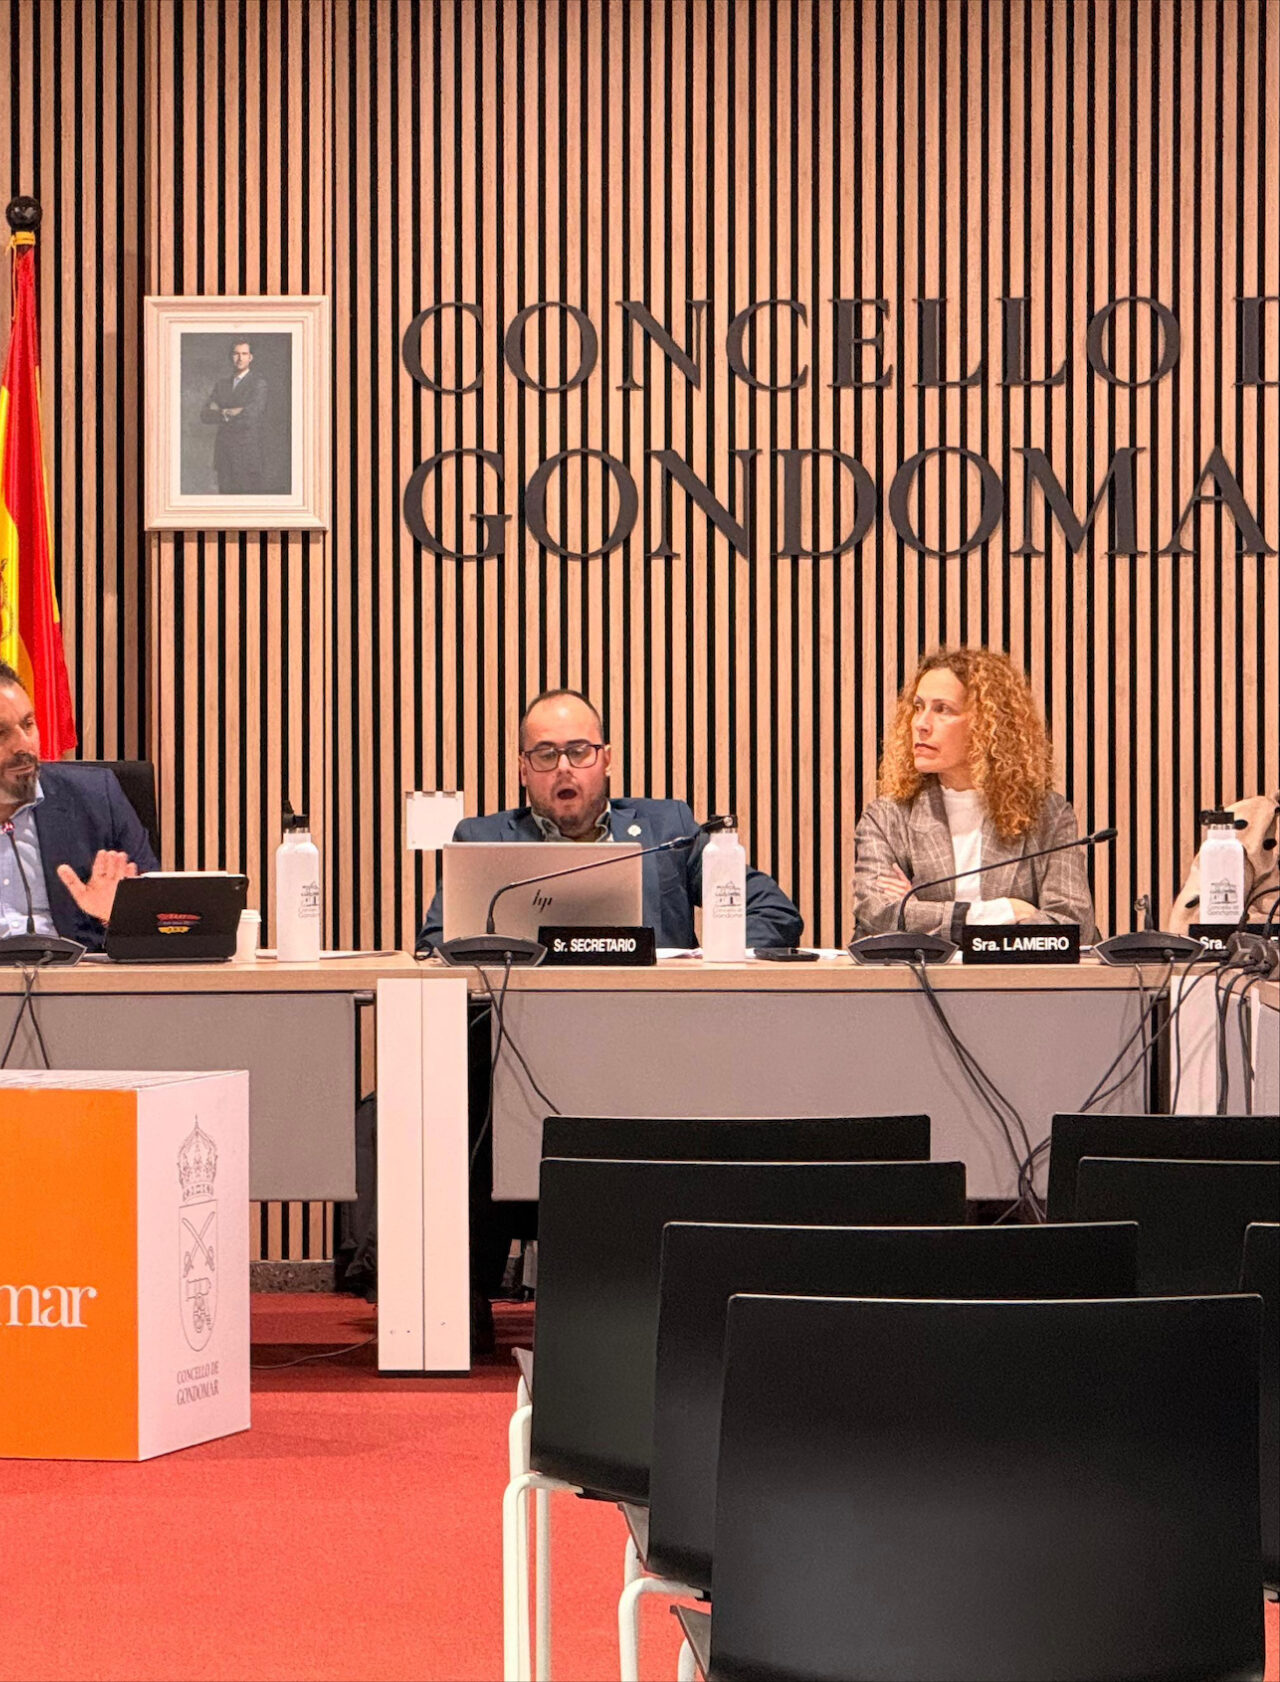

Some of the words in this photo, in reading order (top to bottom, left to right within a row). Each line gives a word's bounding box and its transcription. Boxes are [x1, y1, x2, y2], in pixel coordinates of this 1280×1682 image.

[402, 296, 1182, 395] CONCELLO
[403, 445, 1279, 562] GONDOMA
[532, 889, 553, 913] hp
[553, 938, 569, 953] Sr.
[570, 938, 637, 953] SECRETARIO
[972, 937, 1001, 952] Sra.
[1003, 936, 1070, 951] LAMEIRO
[1200, 936, 1227, 950] Sra.
